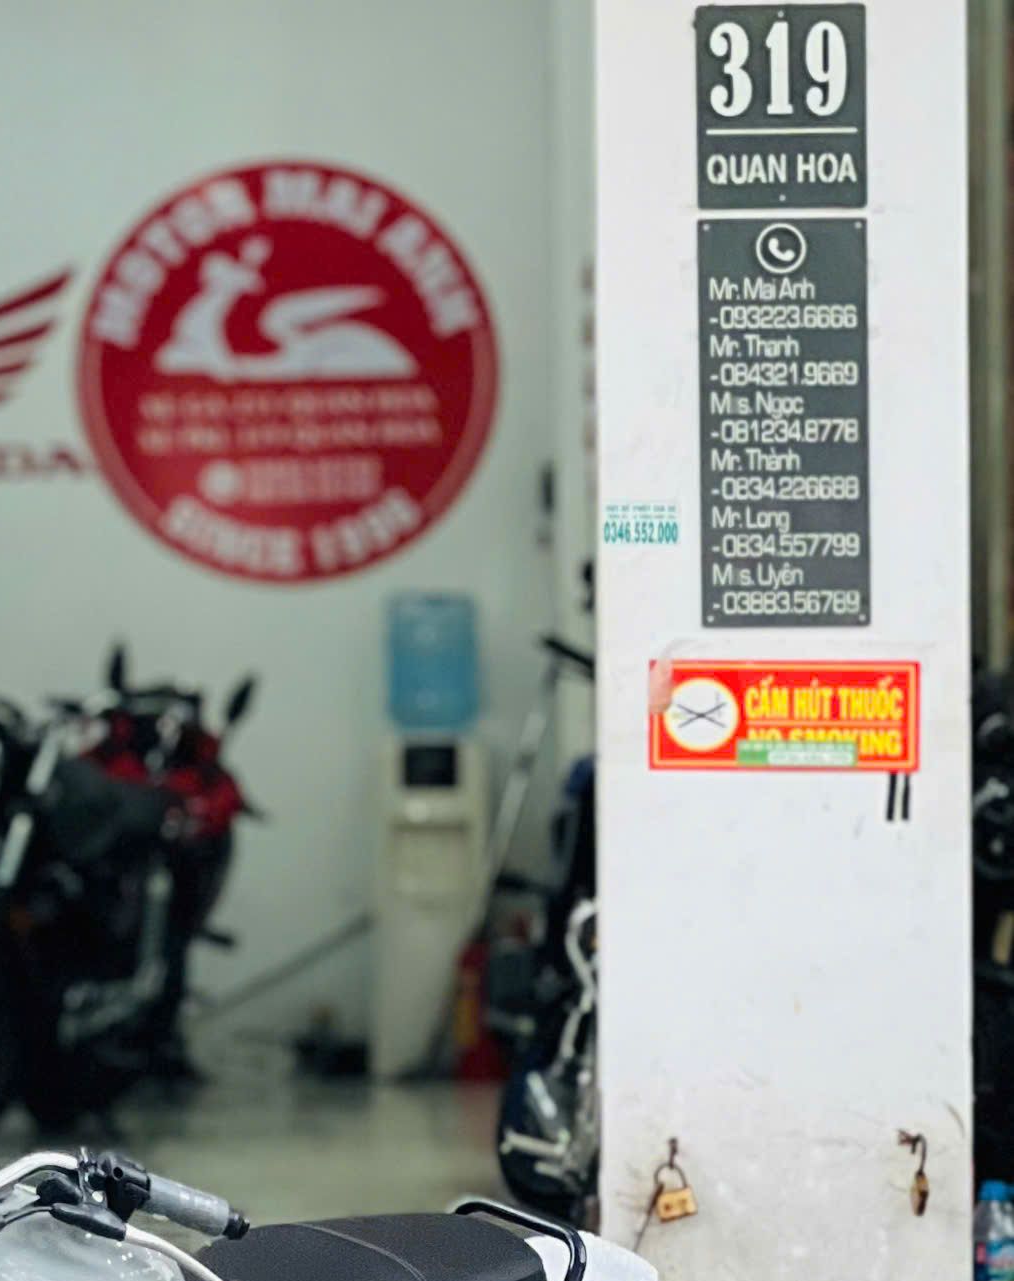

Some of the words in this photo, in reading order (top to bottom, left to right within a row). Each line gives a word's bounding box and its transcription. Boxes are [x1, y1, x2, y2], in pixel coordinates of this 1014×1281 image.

[709, 21, 847, 117] 319
[706, 153, 787, 185] QUAN
[796, 153, 857, 183] HOA
[91, 175, 259, 350] MOTOR
[262, 167, 387, 241] MAI
[709, 277, 740, 300] Mr.
[743, 277, 776, 300] Mai
[779, 277, 815, 300] Anh
[710, 334, 742, 357] Mr.
[744, 334, 800, 357] Thanh
[711, 448, 743, 471] Mr.
[712, 505, 743, 528] Mr.
[745, 505, 790, 534] Long
[745, 674, 789, 719] CẤM
[793, 677, 833, 720] HÚT
[837, 675, 904, 720] THUỐC
